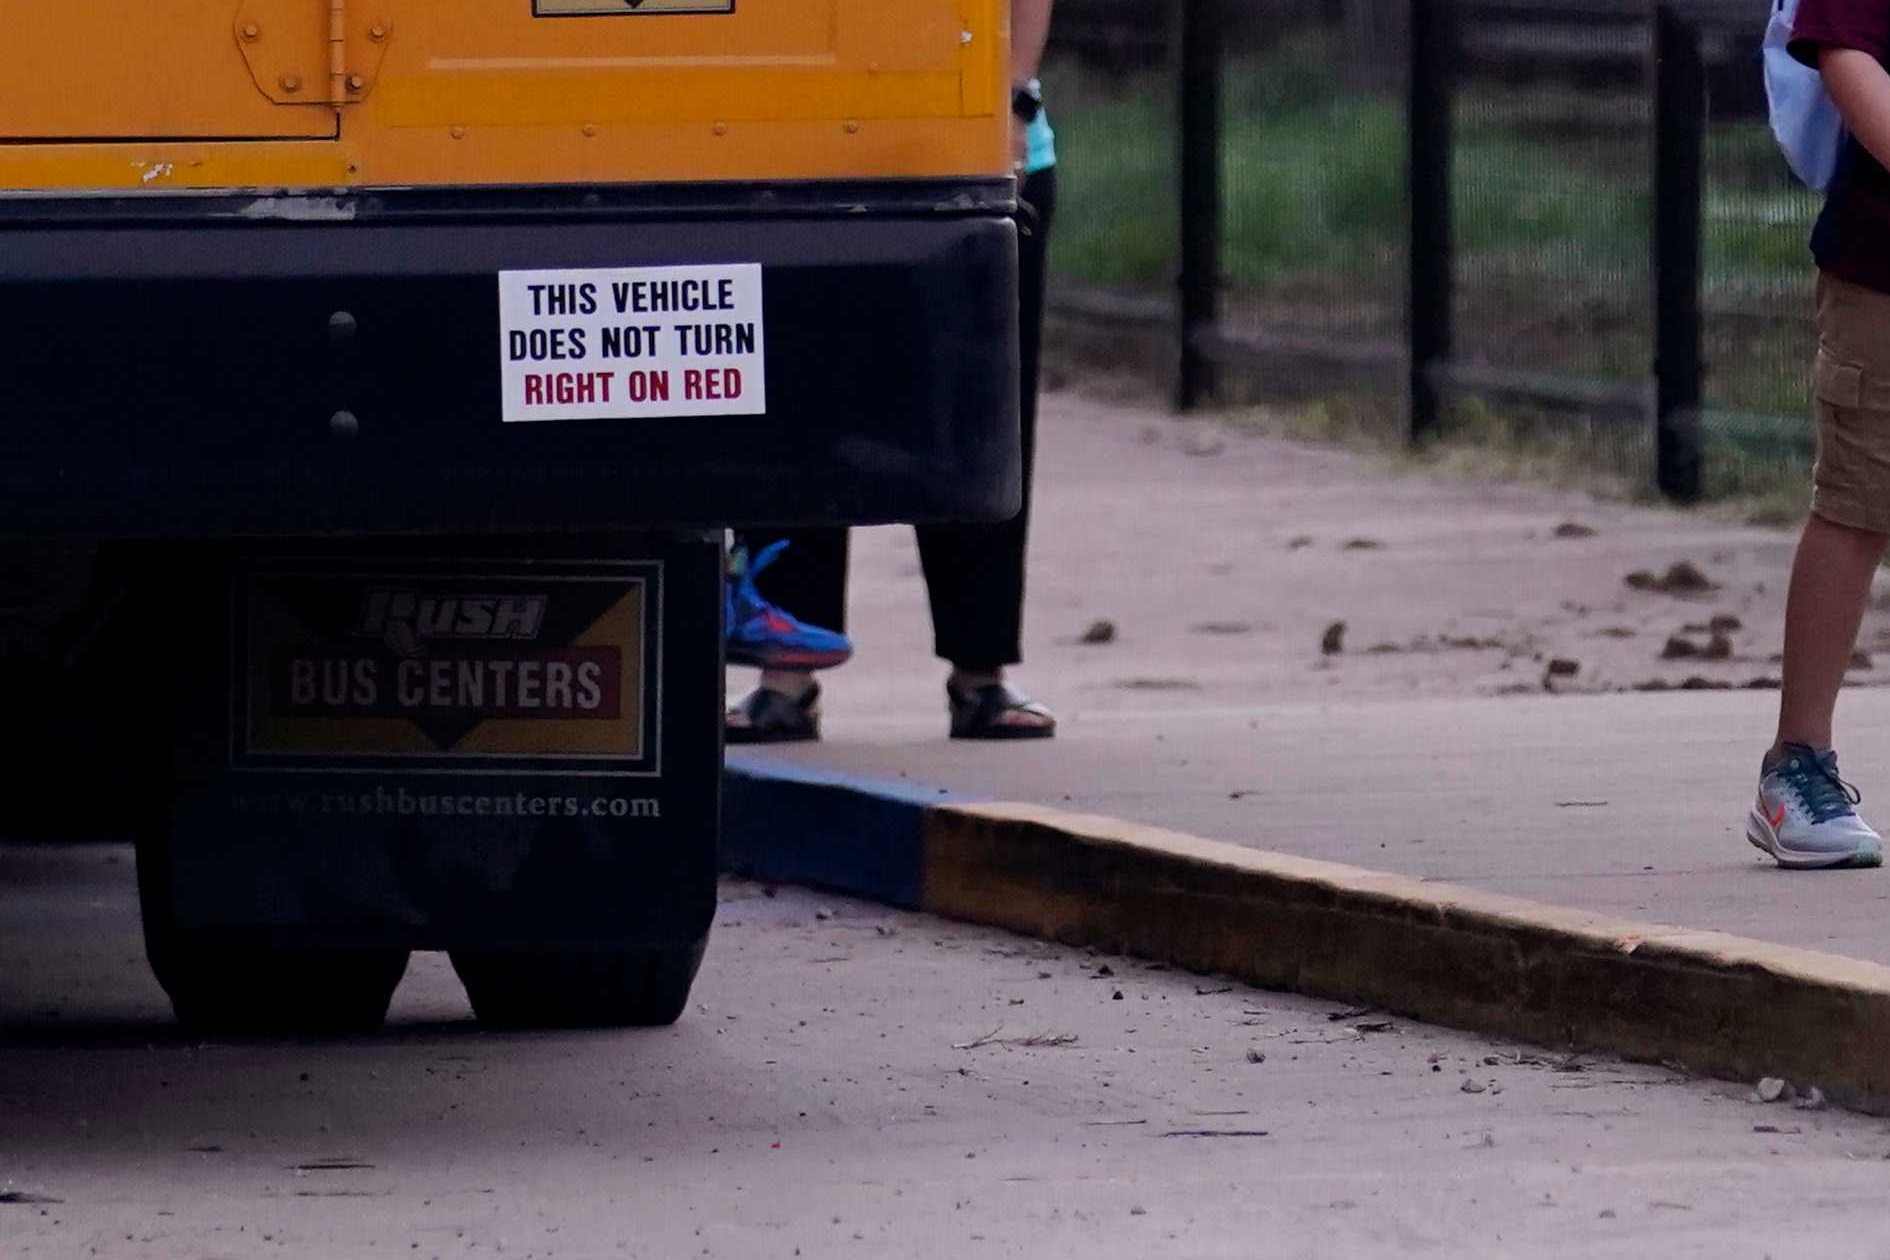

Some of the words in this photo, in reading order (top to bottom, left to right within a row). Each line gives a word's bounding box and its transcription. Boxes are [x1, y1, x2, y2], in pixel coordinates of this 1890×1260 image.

[527, 283, 597, 316] THIS
[612, 279, 734, 313] VEHICLE
[510, 328, 586, 361] DOES
[602, 326, 661, 358] NOT
[674, 323, 755, 356] TURN
[525, 372, 615, 405] RIGHT
[629, 370, 669, 402] ON
[684, 368, 742, 400] RED
[352, 587, 549, 657] RUSH
[290, 657, 378, 707] BUS
[397, 658, 602, 710] CENTERS
[230, 787, 662, 819] www.rushbuscenters.com
